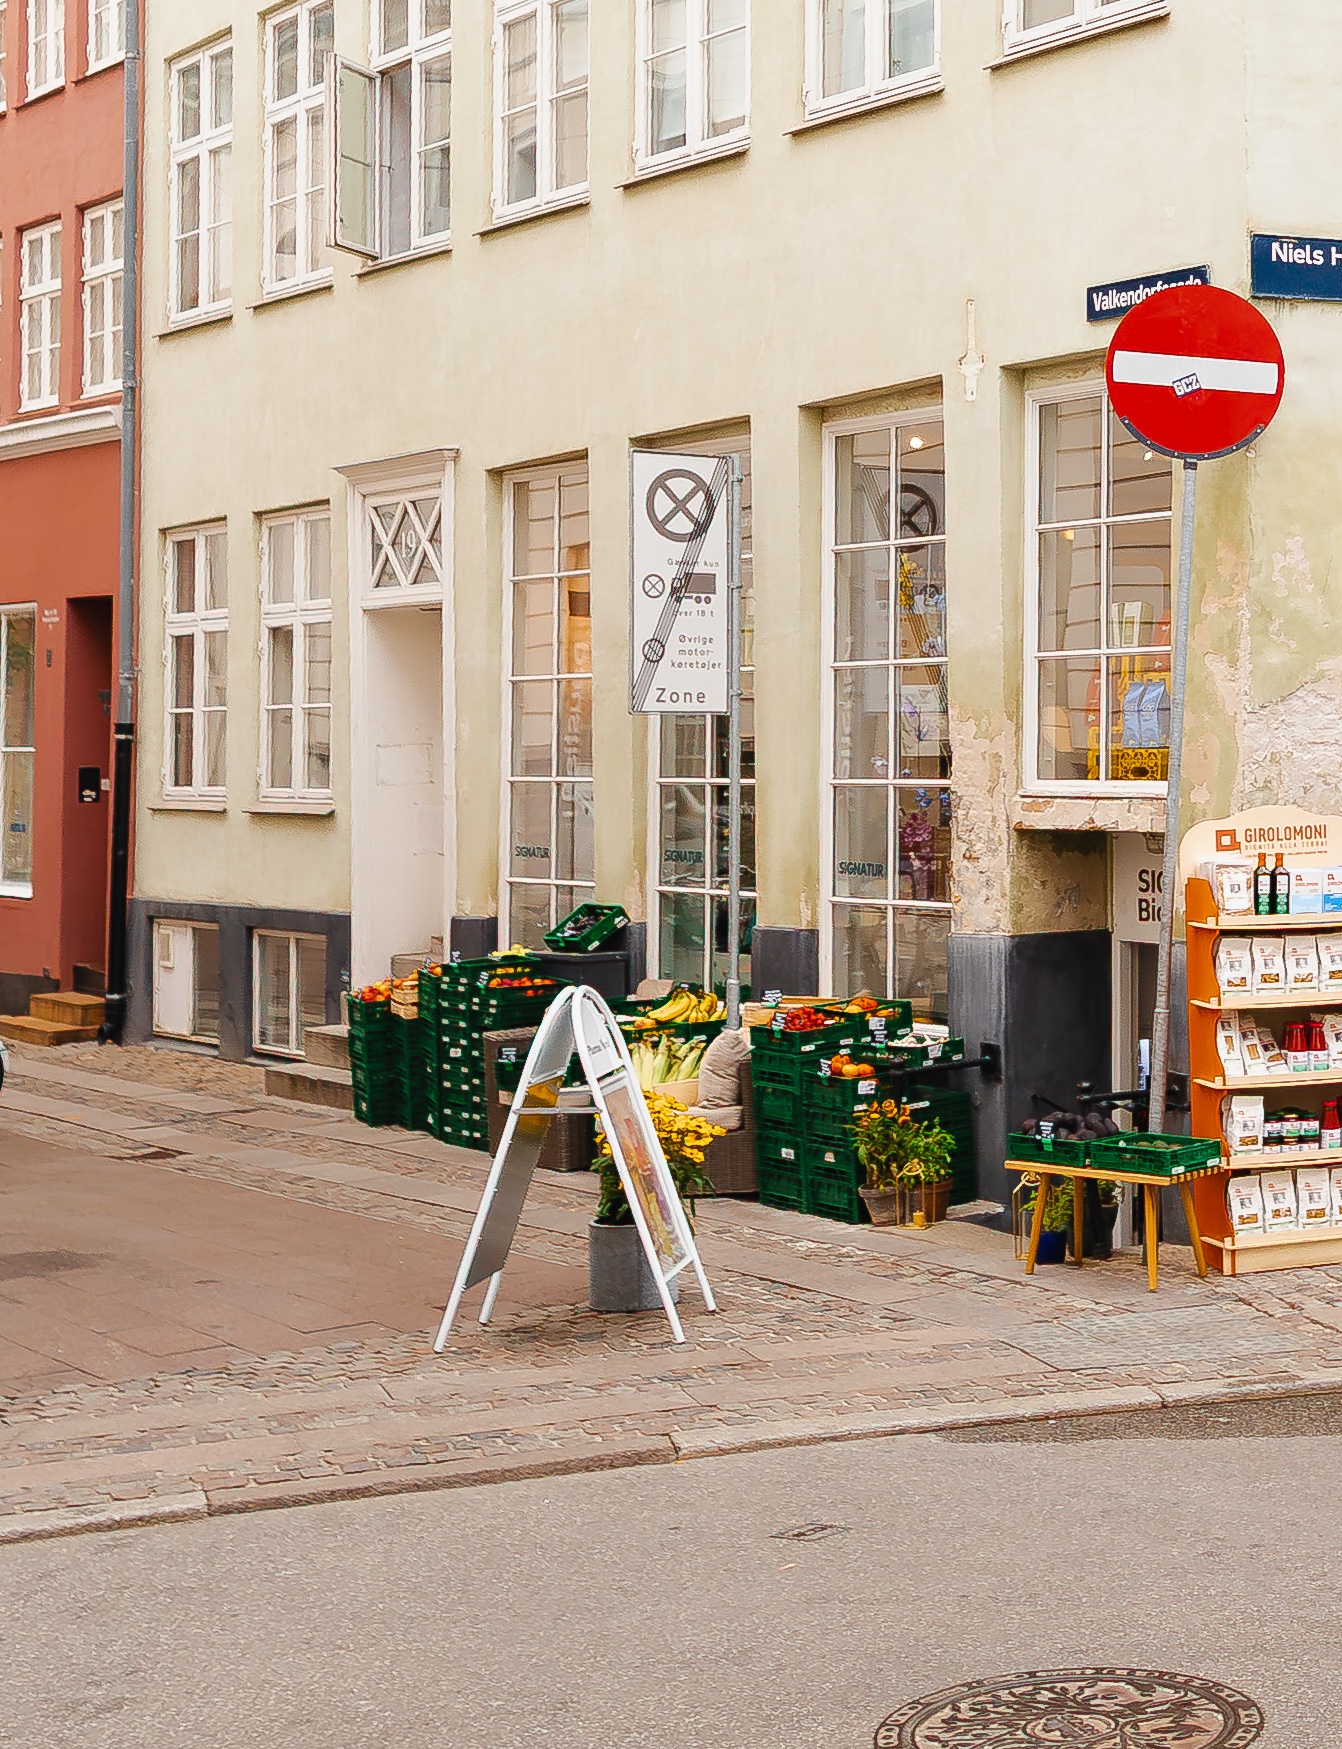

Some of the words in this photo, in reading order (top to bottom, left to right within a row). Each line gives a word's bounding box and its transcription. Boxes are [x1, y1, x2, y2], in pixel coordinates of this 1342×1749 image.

[1271, 242, 1324, 266] Niels
[678, 634, 715, 646] Øvrige
[678, 648, 714, 657] motor-
[656, 687, 706, 703] Zone
[1244, 824, 1327, 843] GIROLOMONI
[839, 861, 884, 877] SIGNATUR
